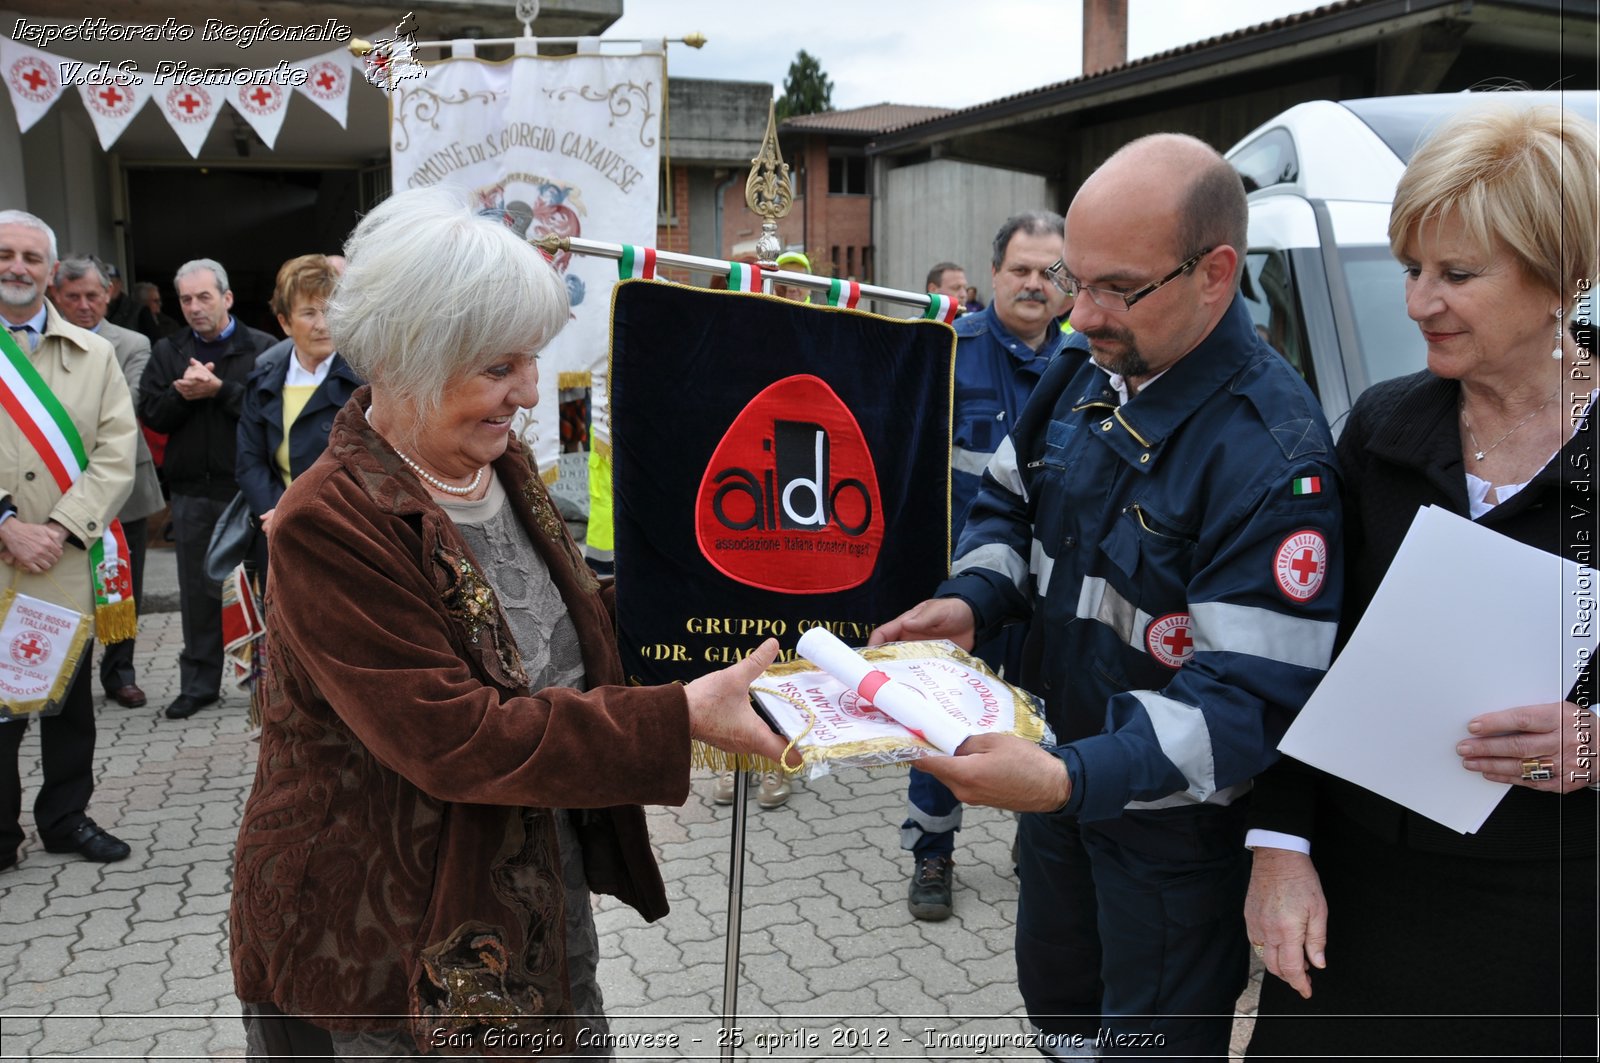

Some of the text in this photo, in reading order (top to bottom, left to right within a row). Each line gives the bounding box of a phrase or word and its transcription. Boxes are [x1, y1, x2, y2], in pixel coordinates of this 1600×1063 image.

[467, 143, 486, 164] DI
[560, 131, 644, 194] CANAVESE
[713, 430, 872, 537] aido
[715, 536, 781, 551] associazione
[784, 536, 814, 551] italiana
[817, 538, 848, 554] donatori
[17, 604, 72, 630] CROCE ROSSA
[20, 617, 60, 636] ITALIANA
[686, 616, 787, 637] GRUPPO
[908, 664, 940, 690] LOCALE
[805, 687, 854, 730] ITALIANA
